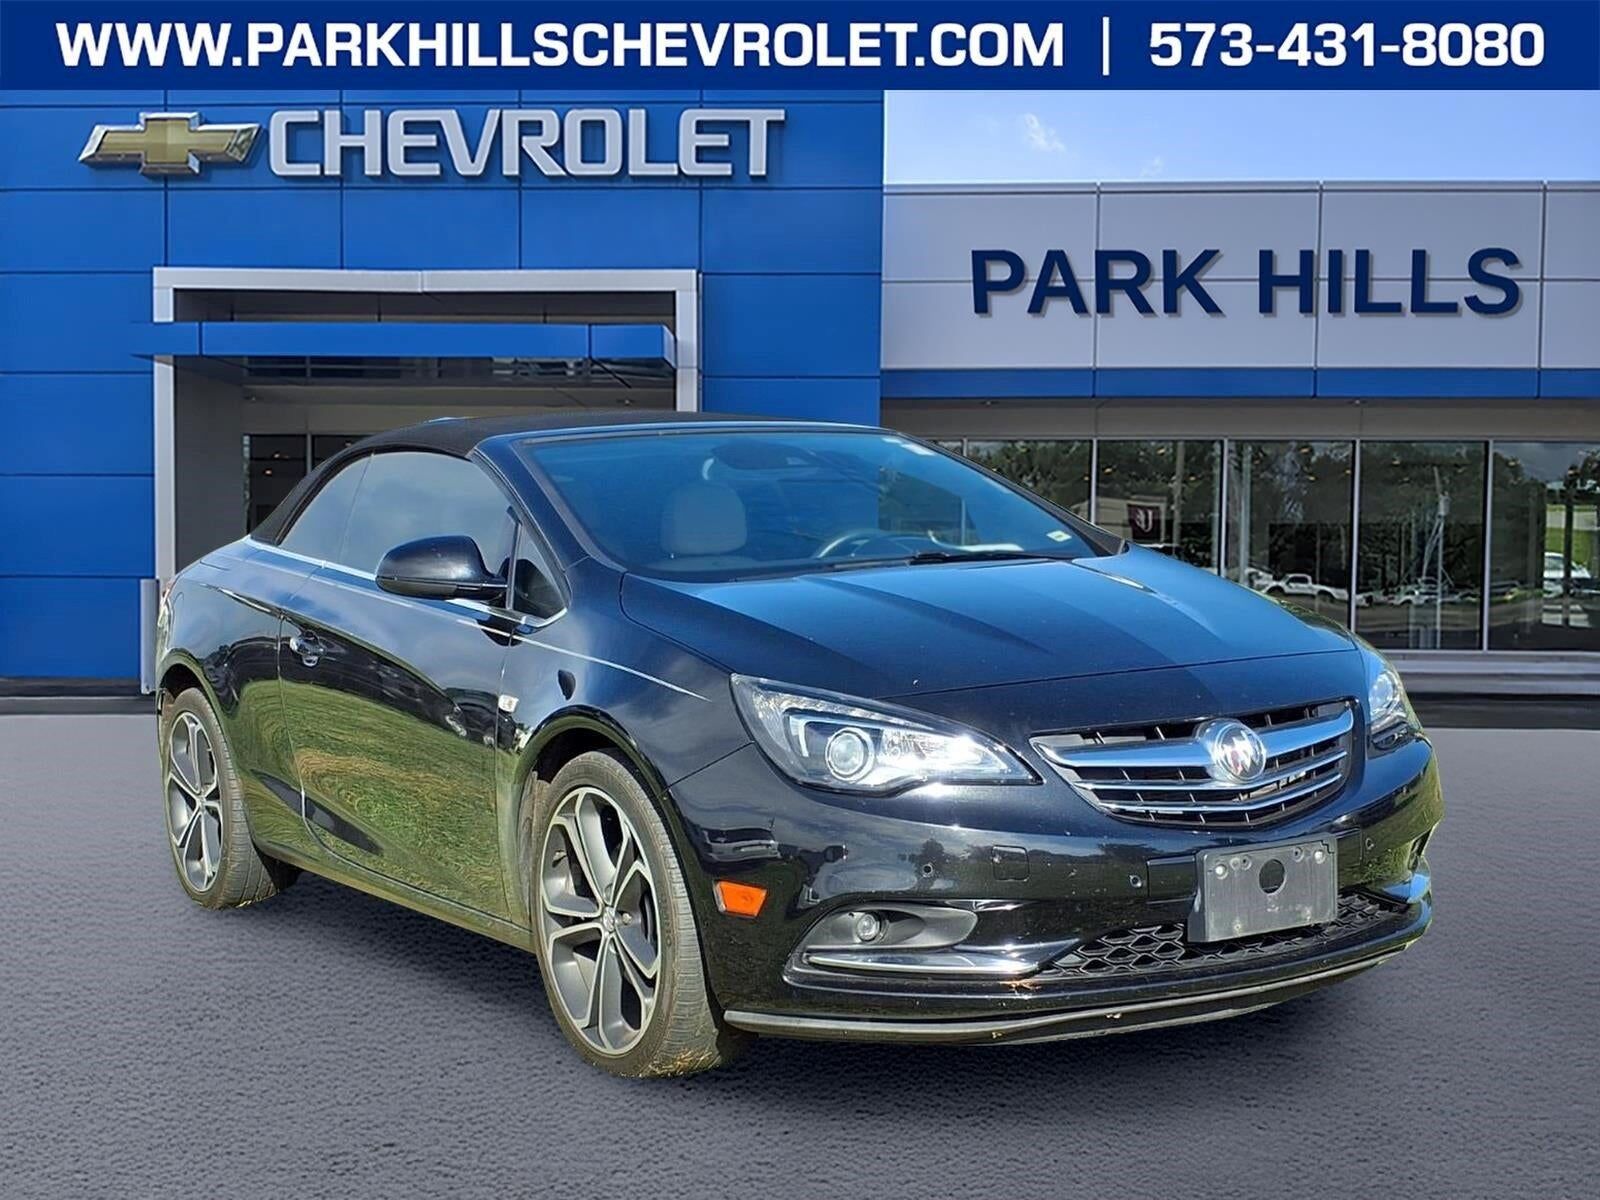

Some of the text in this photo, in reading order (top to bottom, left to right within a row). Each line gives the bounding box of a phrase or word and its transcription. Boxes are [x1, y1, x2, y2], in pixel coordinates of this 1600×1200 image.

[268, 108, 786, 178] CHEVROLET
[970, 247, 1523, 316] PARK HILLS
